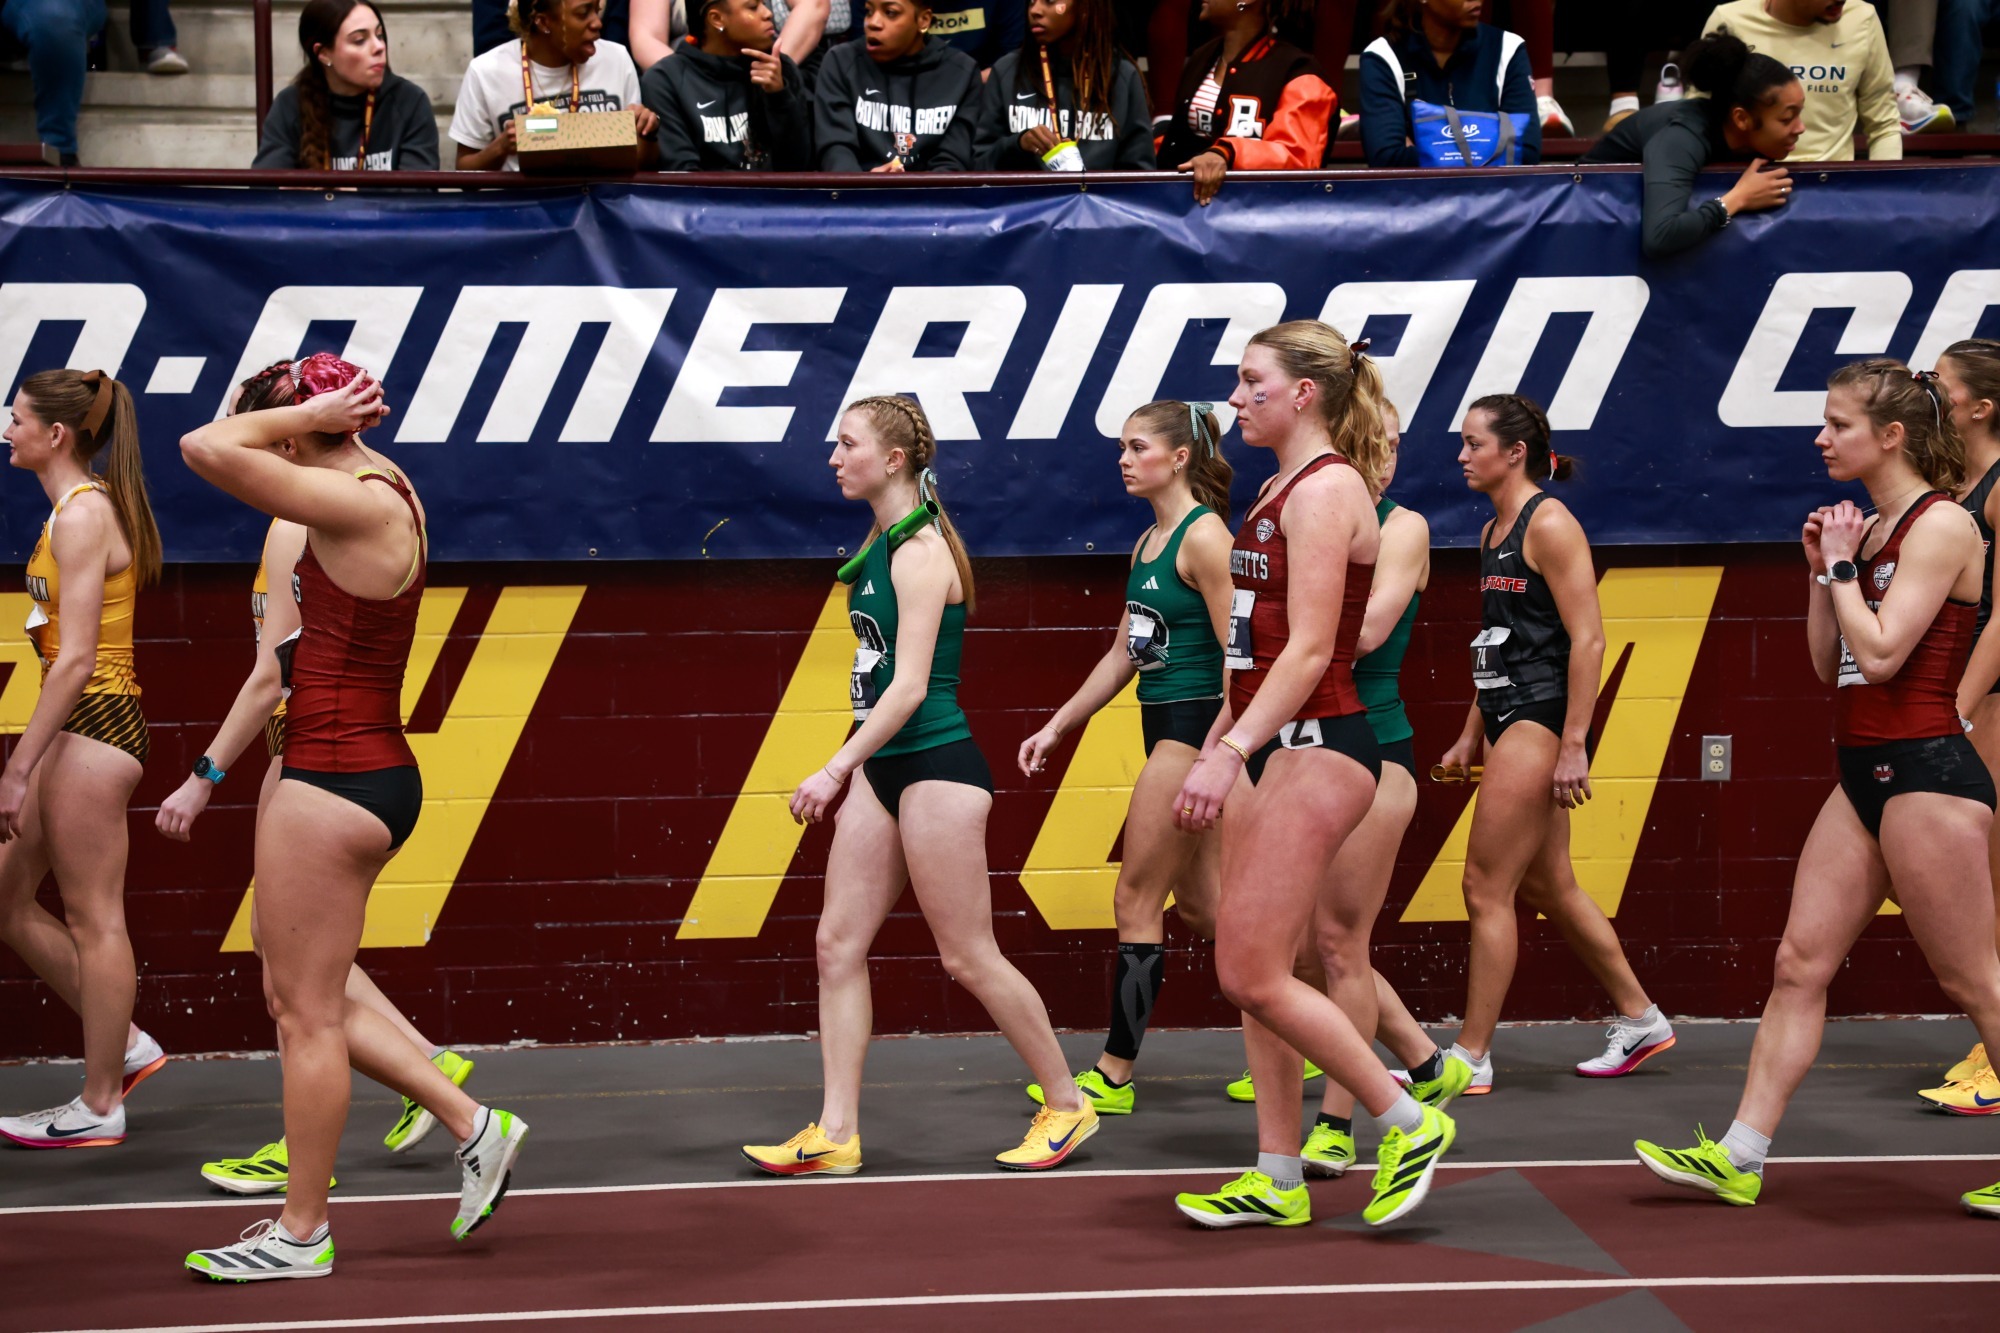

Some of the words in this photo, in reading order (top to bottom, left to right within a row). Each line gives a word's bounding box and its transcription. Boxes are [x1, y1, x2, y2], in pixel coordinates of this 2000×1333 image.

[1807, 84, 1839, 93] FIELD
[856, 95, 911, 134] BOWLING
[1008, 104, 1069, 138] BOWLIG
[1476, 647, 1487, 670] 74
